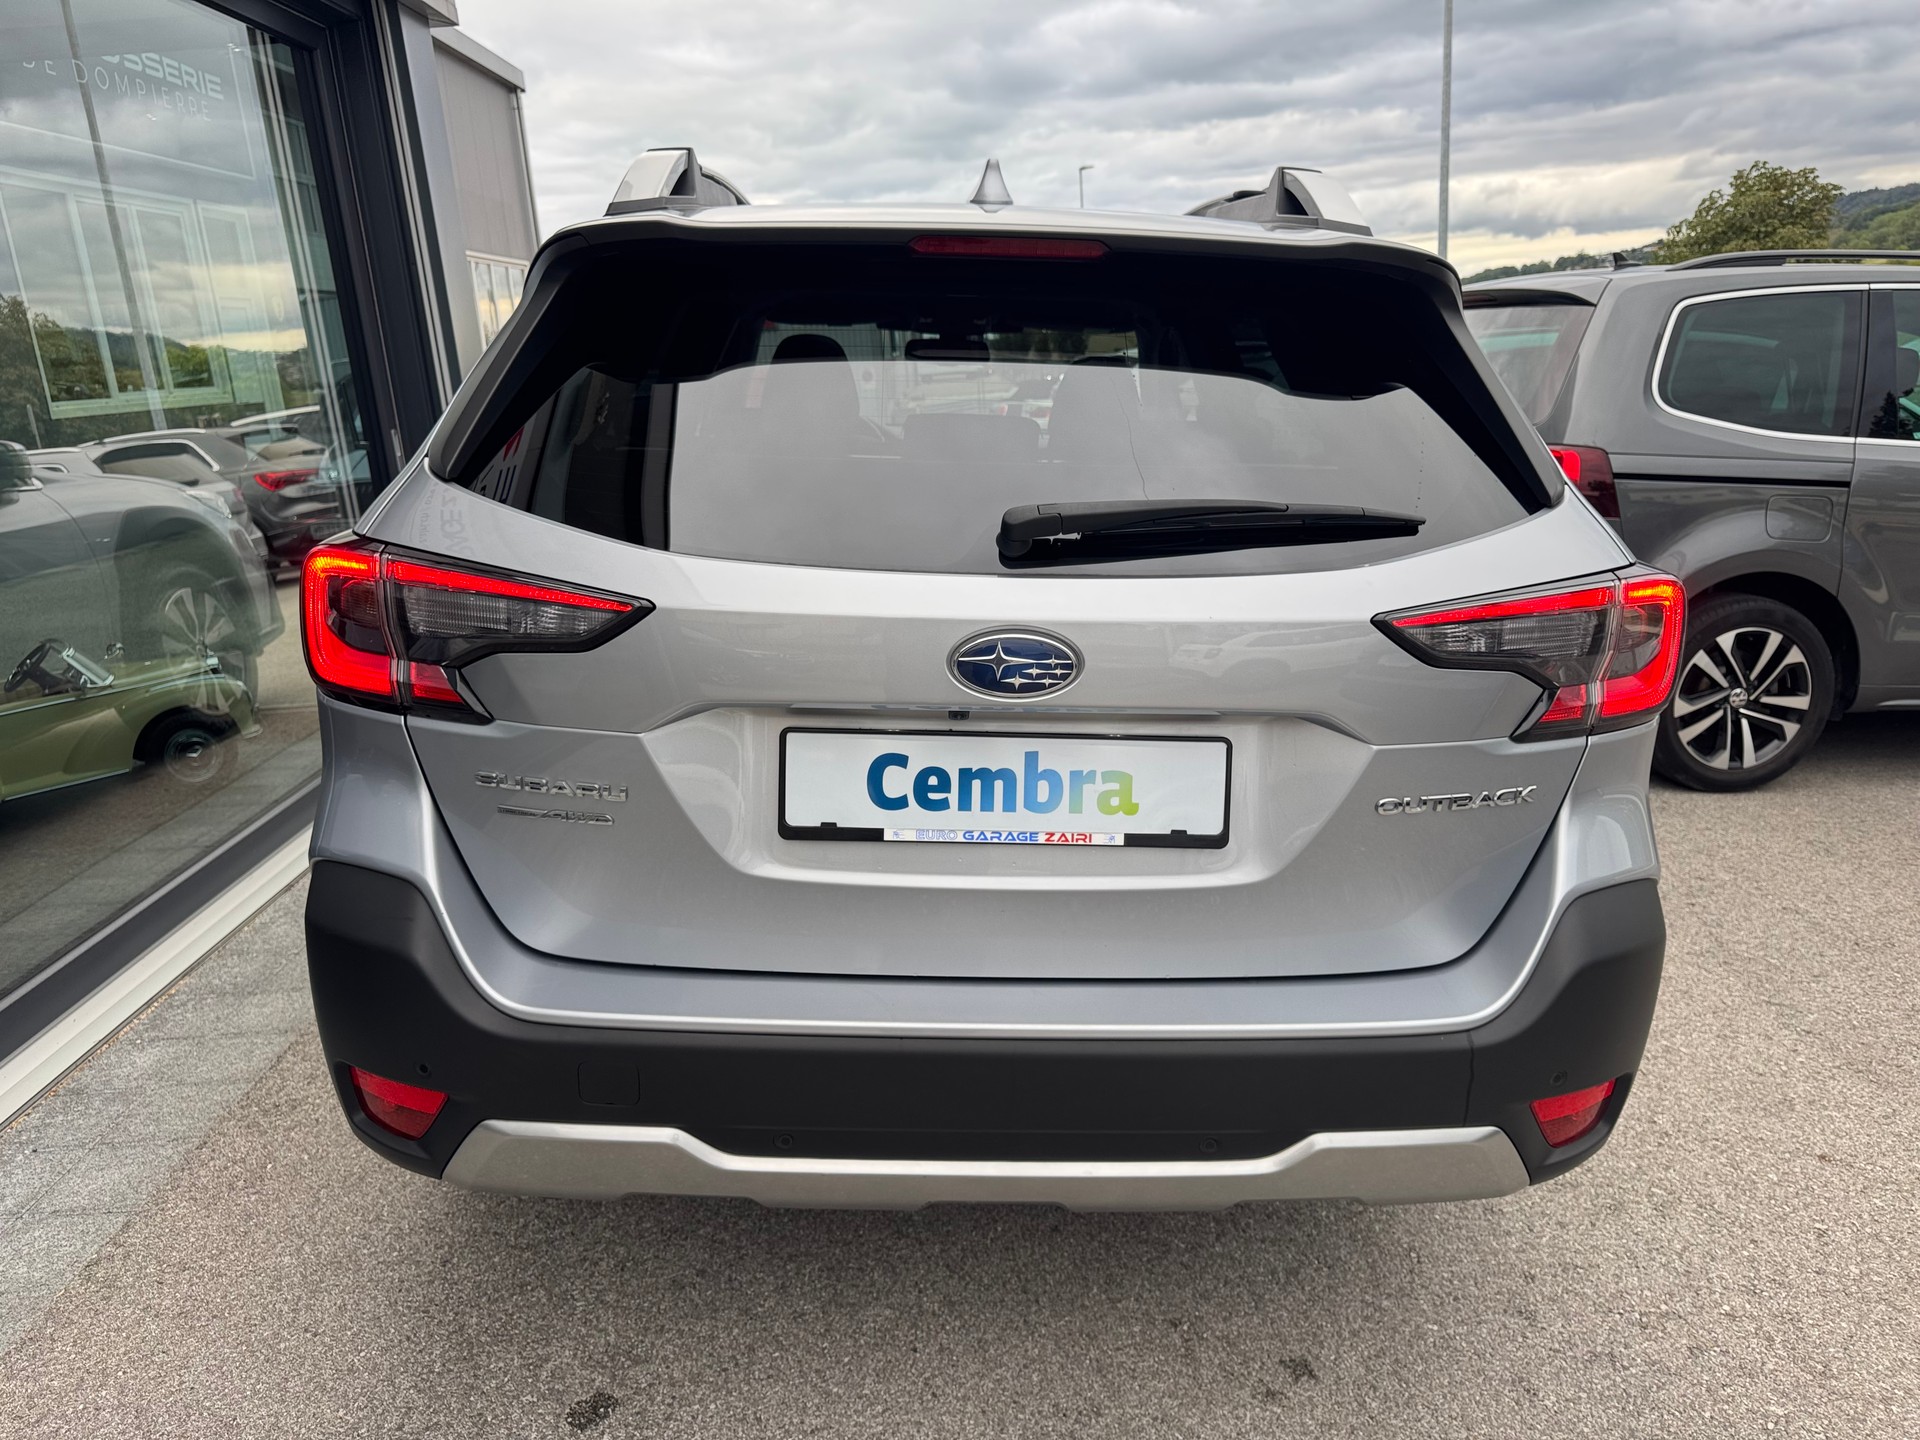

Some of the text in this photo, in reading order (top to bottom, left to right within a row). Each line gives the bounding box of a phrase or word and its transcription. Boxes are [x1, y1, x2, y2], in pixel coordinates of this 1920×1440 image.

[71, 58, 212, 122] DOMPIERRE
[474, 770, 628, 802] SUBARU
[866, 750, 1140, 817] Cembra
[1374, 785, 1538, 816] OUTBACK
[915, 829, 1093, 844] EURO GARAGE ZAIRI
